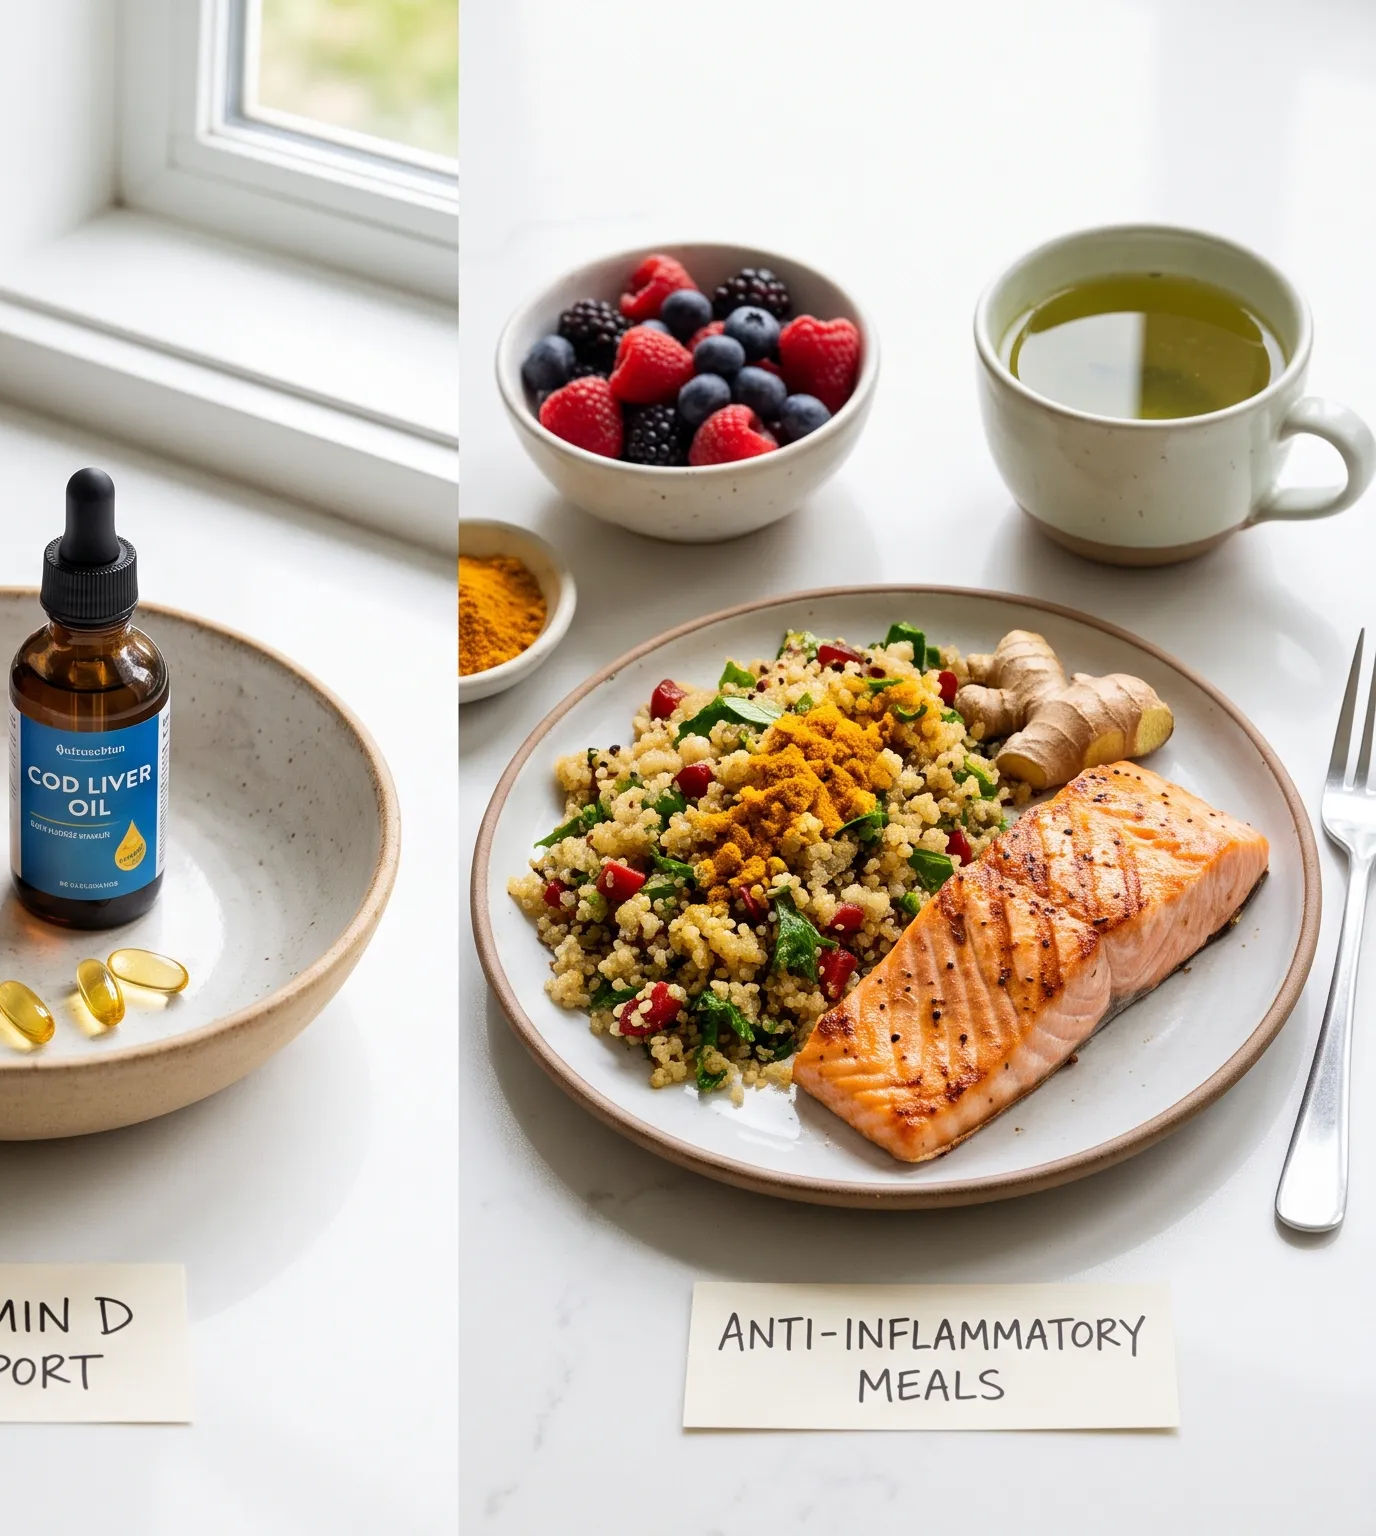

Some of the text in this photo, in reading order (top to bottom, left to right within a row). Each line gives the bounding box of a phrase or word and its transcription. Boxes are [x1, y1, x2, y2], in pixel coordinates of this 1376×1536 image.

[28, 764, 151, 794] COD LIVER
[68, 799, 111, 816] OIL
[94, 1296, 134, 1335] D
[718, 1312, 1146, 1356] ANTI-INFLAMMATORY
[858, 1368, 1005, 1403] MEALS
